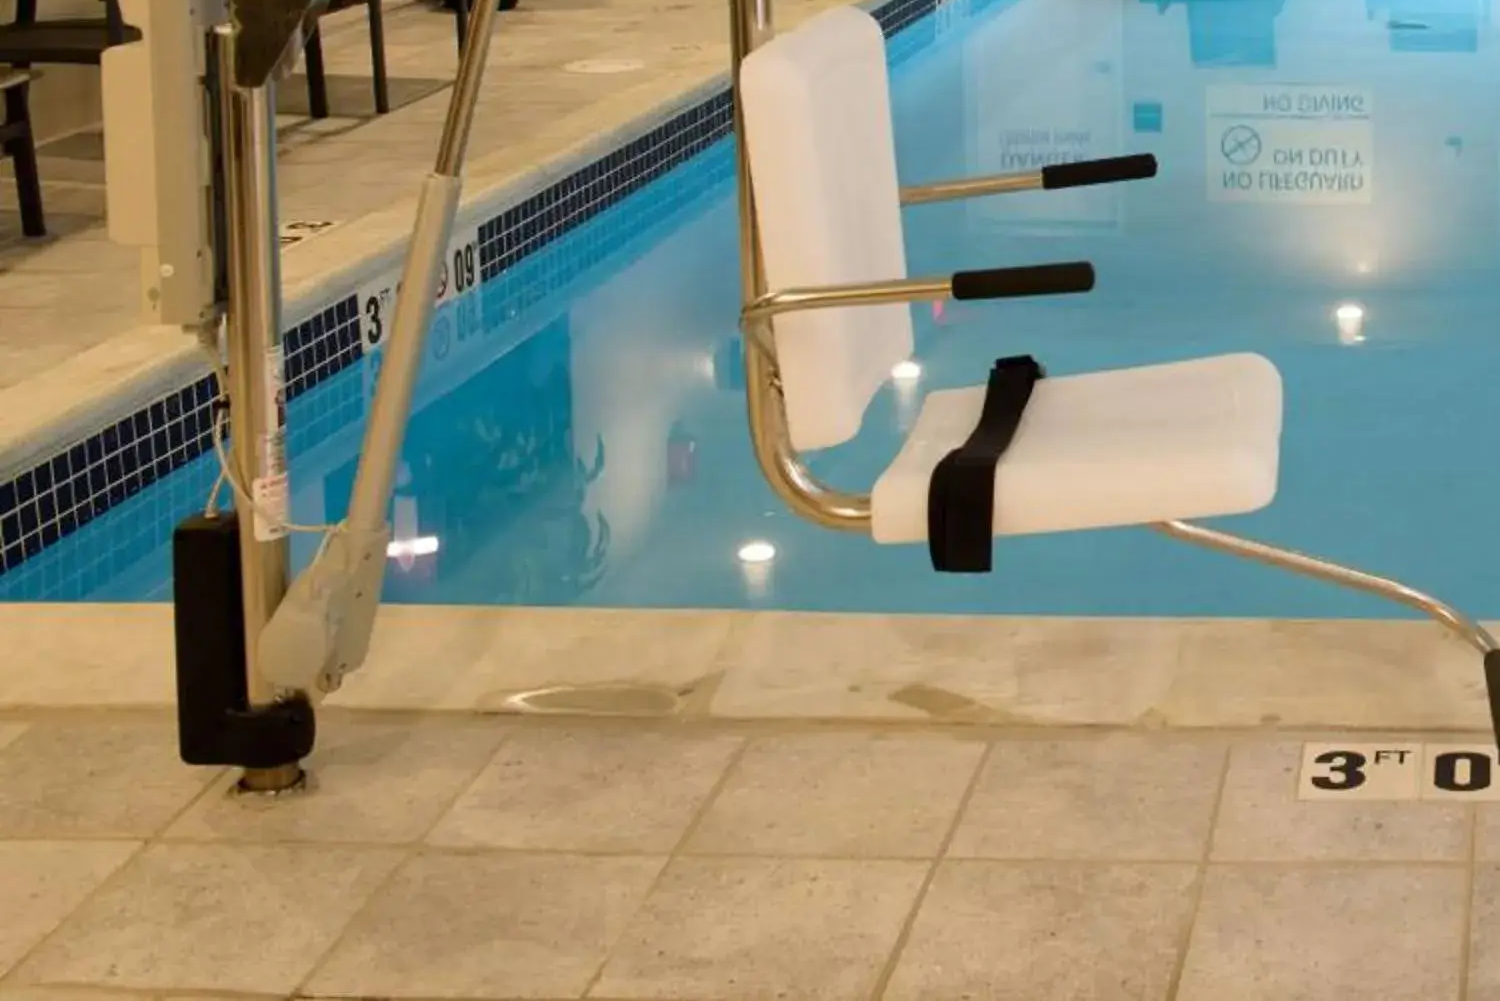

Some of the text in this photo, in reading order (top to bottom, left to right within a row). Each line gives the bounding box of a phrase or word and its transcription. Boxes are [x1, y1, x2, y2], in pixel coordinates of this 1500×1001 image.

[366, 296, 382, 344] 3
[1311, 751, 1367, 790] 3
[1373, 751, 1413, 765] FT
[1433, 752, 1492, 792] 0
